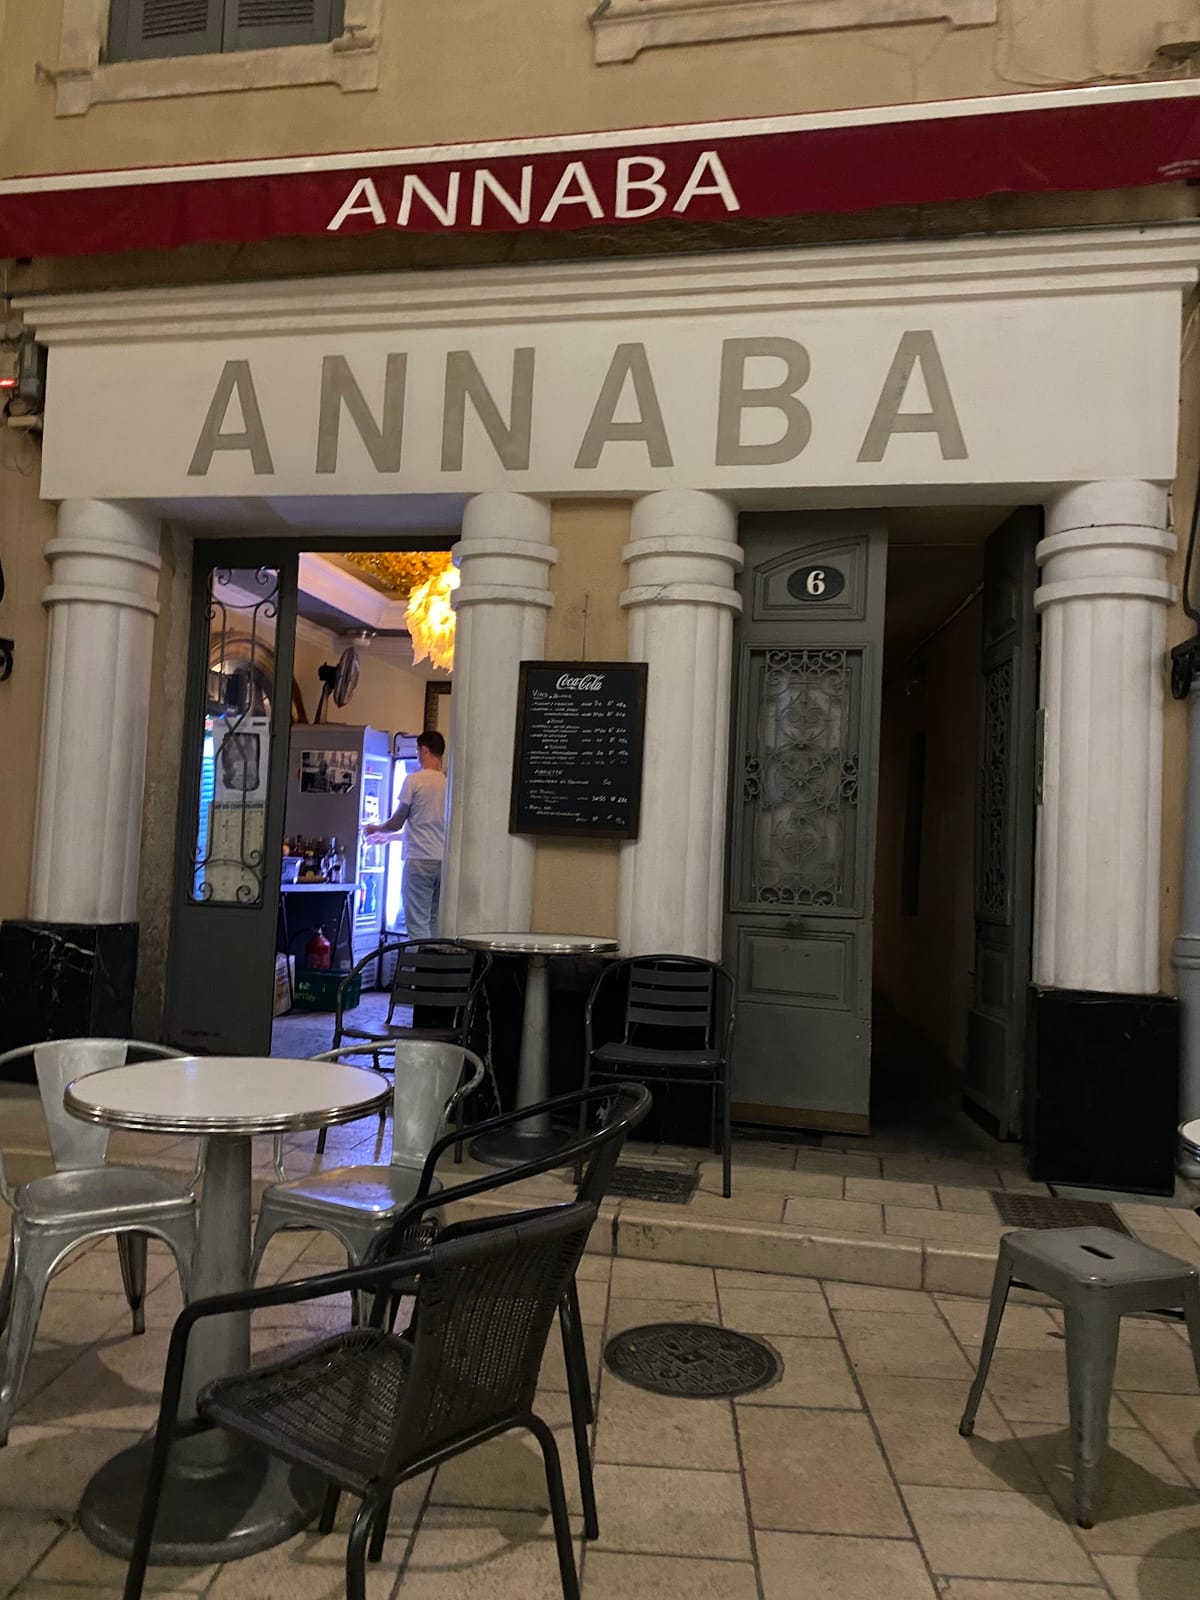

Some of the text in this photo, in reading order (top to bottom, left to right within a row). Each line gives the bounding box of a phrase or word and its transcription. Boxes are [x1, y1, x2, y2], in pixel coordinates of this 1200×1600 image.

[327, 150, 741, 231] ANNABA
[187, 329, 968, 477] ANNABA
[806, 570, 825, 595] 6
